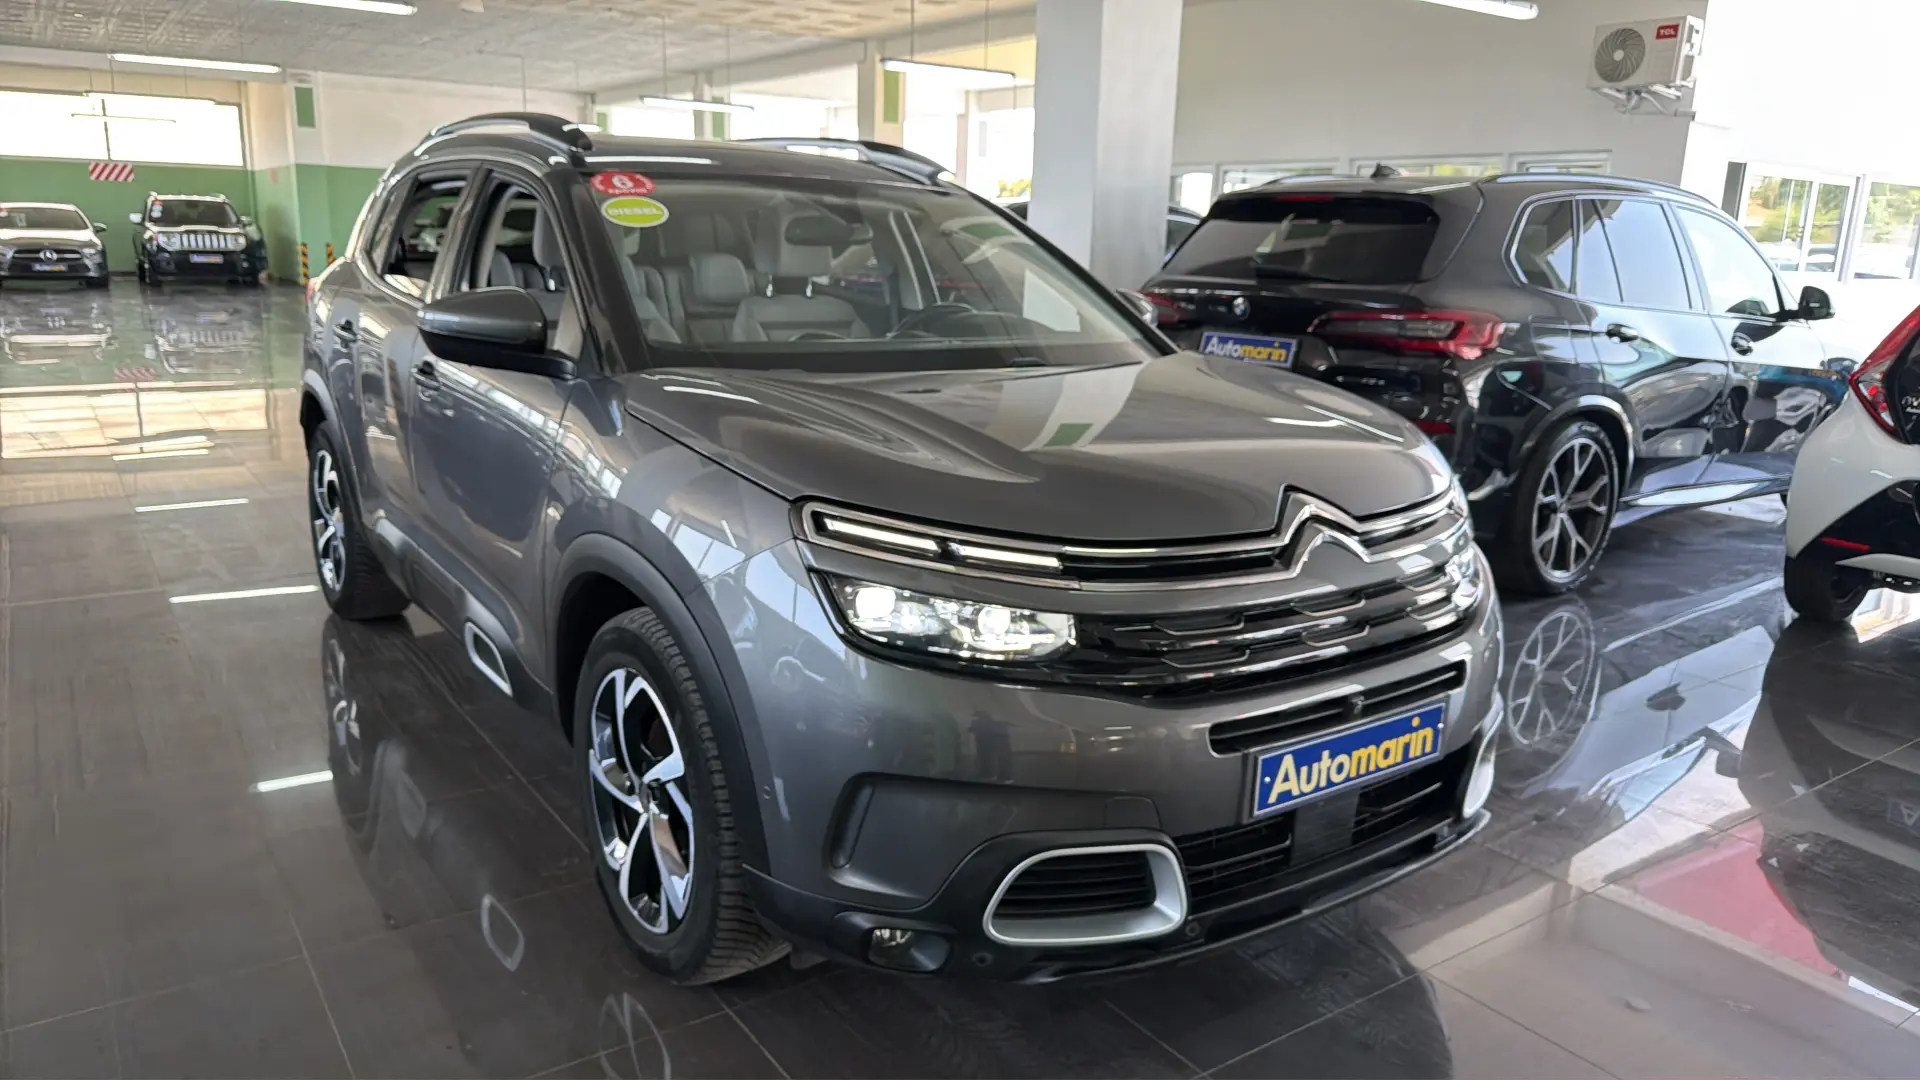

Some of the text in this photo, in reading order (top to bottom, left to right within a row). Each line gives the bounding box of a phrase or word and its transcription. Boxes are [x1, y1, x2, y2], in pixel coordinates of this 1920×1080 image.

[1659, 27, 1676, 36] TCL
[611, 174, 635, 190] 6
[607, 206, 663, 216] DIESEL
[1204, 335, 1288, 362] Automarin
[1266, 715, 1435, 805] Automarin
